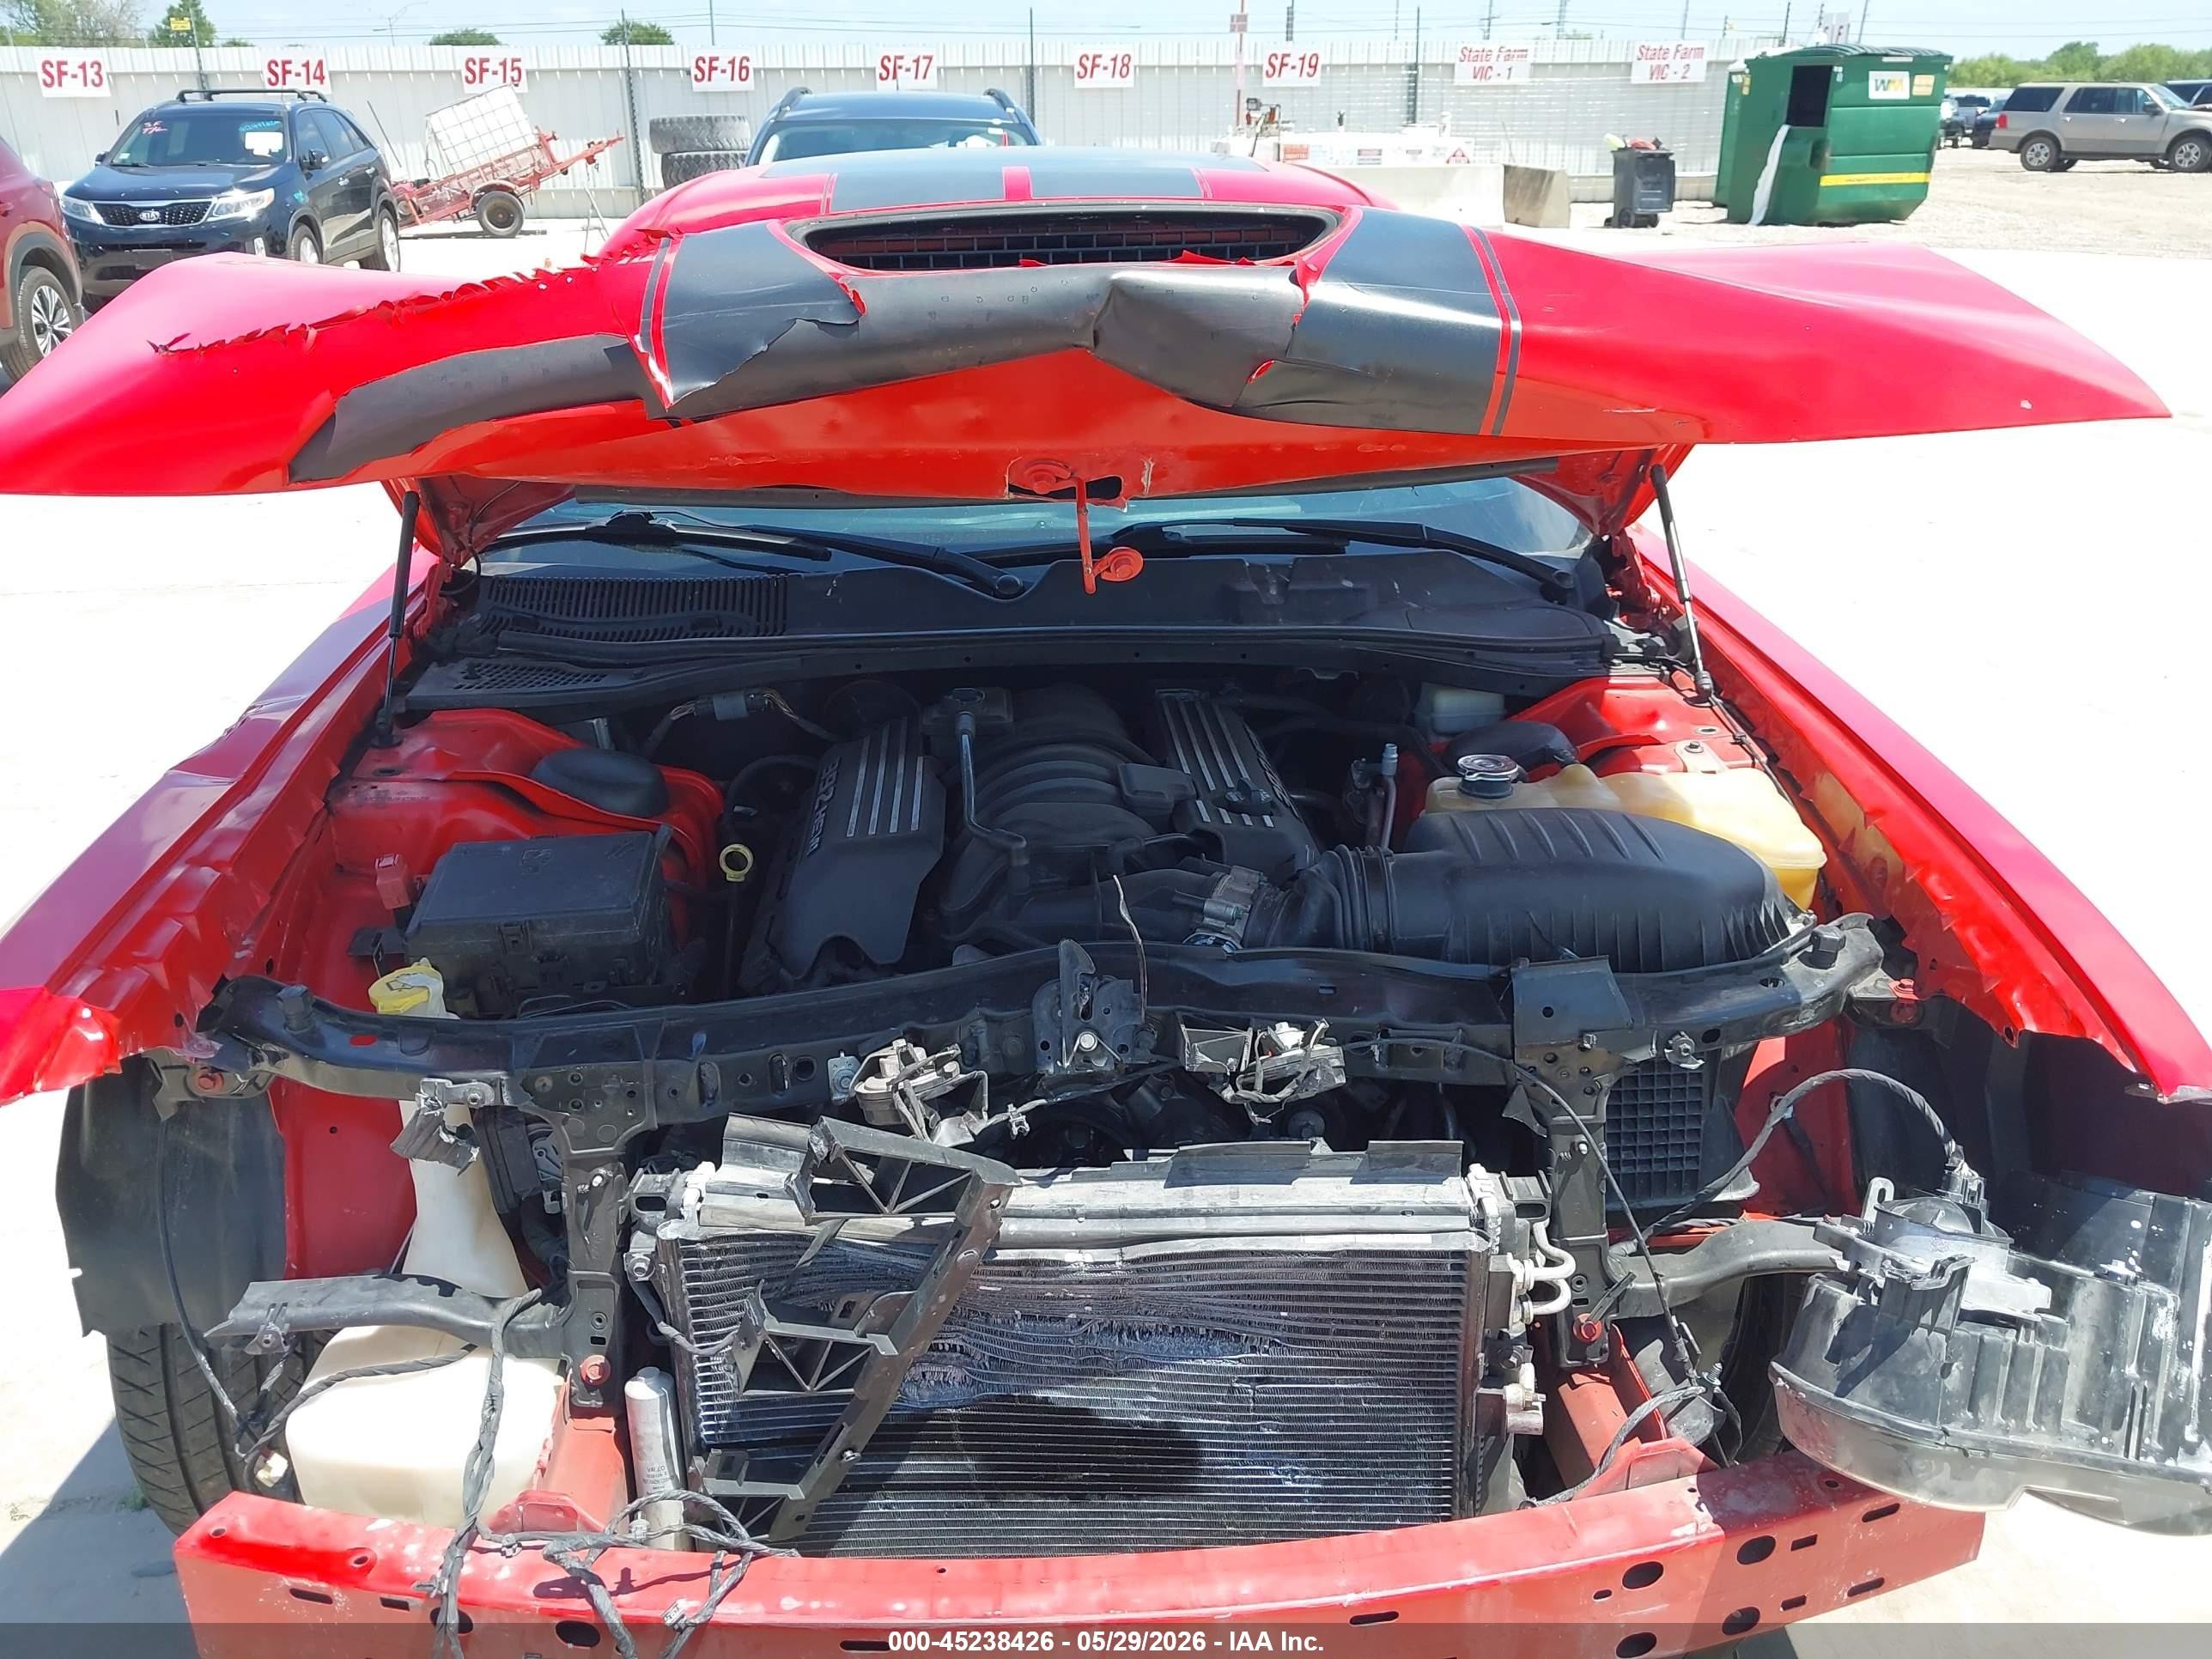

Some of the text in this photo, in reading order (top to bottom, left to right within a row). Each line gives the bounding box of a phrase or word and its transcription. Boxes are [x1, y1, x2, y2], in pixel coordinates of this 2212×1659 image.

[1265, 52, 1319, 78] SF-19
[1460, 46, 1528, 62] State Farm
[1637, 44, 1705, 61] State Farm
[41, 59, 104, 88] SF-13
[267, 58, 325, 87] SF-14
[465, 57, 522, 84] SF-15
[694, 56, 750, 82] SF-16
[878, 54, 934, 81] SF-17
[1077, 53, 1131, 79] SF-18
[1473, 65, 1493, 82] VIC
[1507, 65, 1513, 81] 1
[1650, 64, 1670, 81] VIC
[1680, 64, 1691, 80] 2
[1875, 78, 1904, 91] WM
[140, 210, 160, 221] KIA
